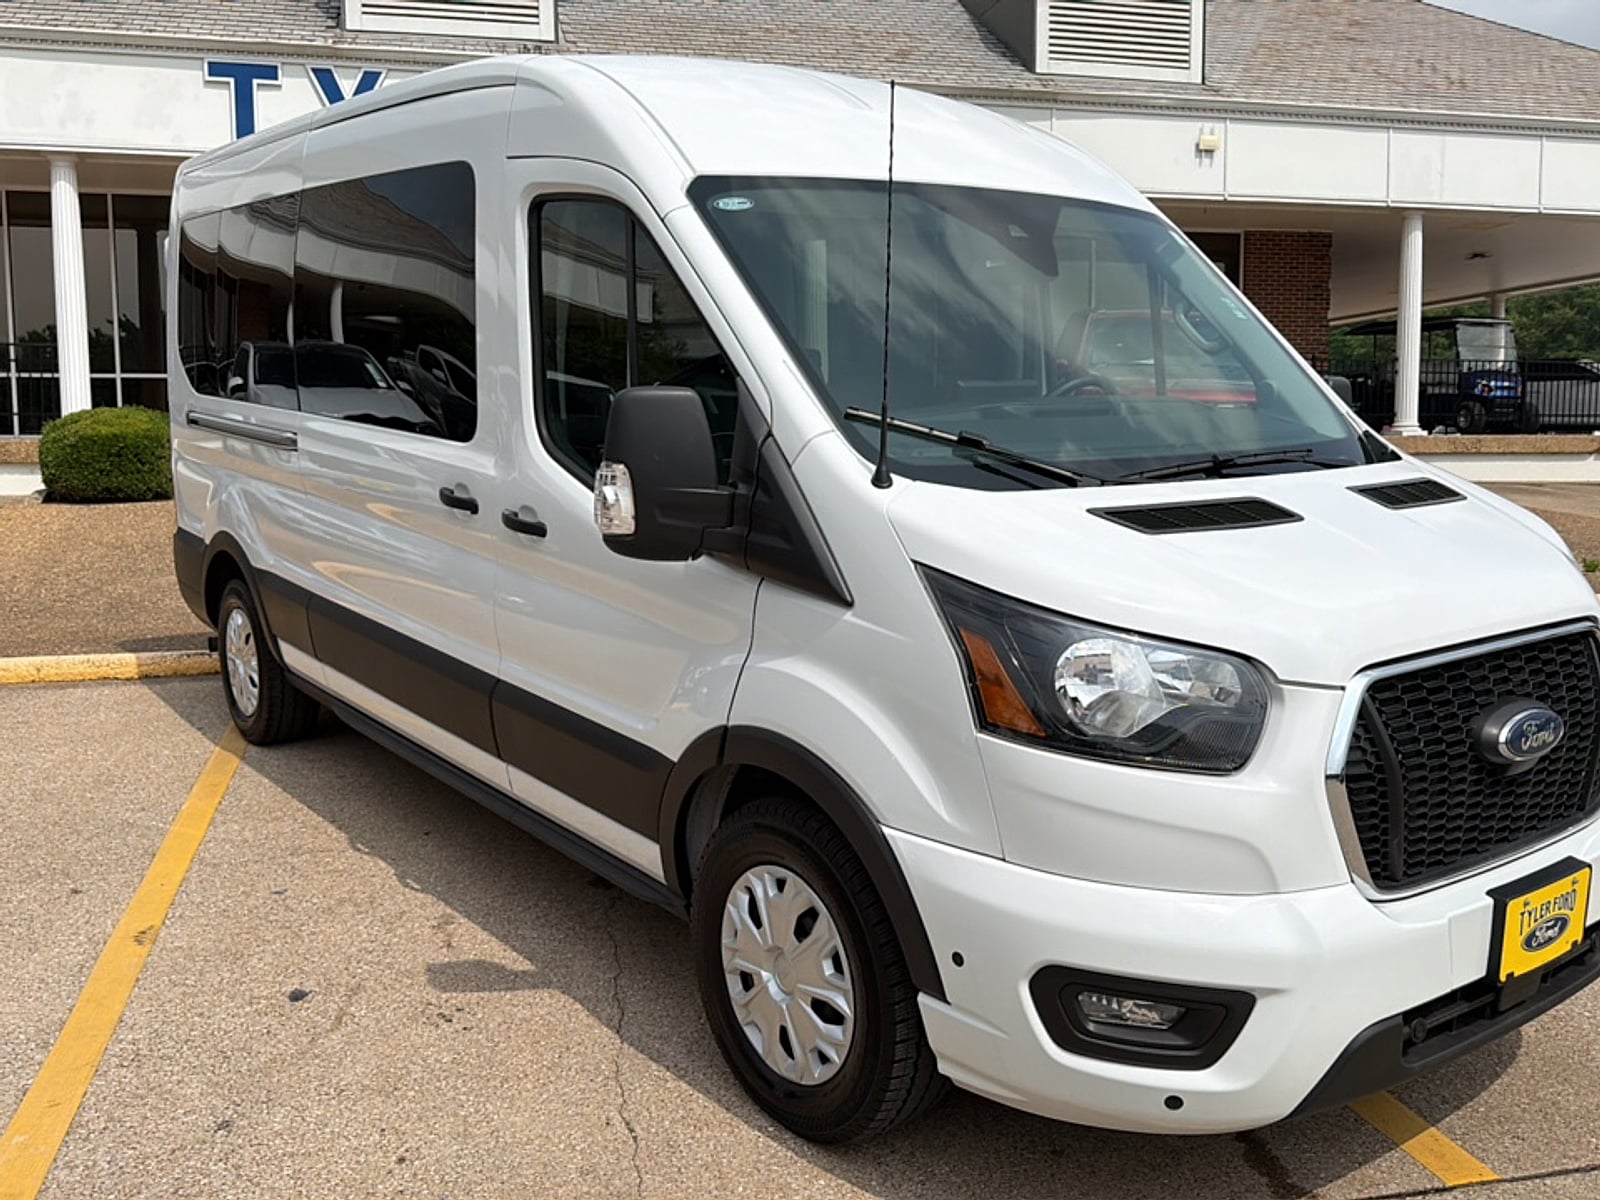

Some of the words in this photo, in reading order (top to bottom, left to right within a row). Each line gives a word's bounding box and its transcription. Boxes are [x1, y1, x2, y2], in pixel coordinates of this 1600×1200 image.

[1521, 720, 1555, 751] Ford
[1520, 900, 1552, 936] TYLER
[1553, 888, 1578, 912] FORD
[1531, 919, 1562, 948] Ford
